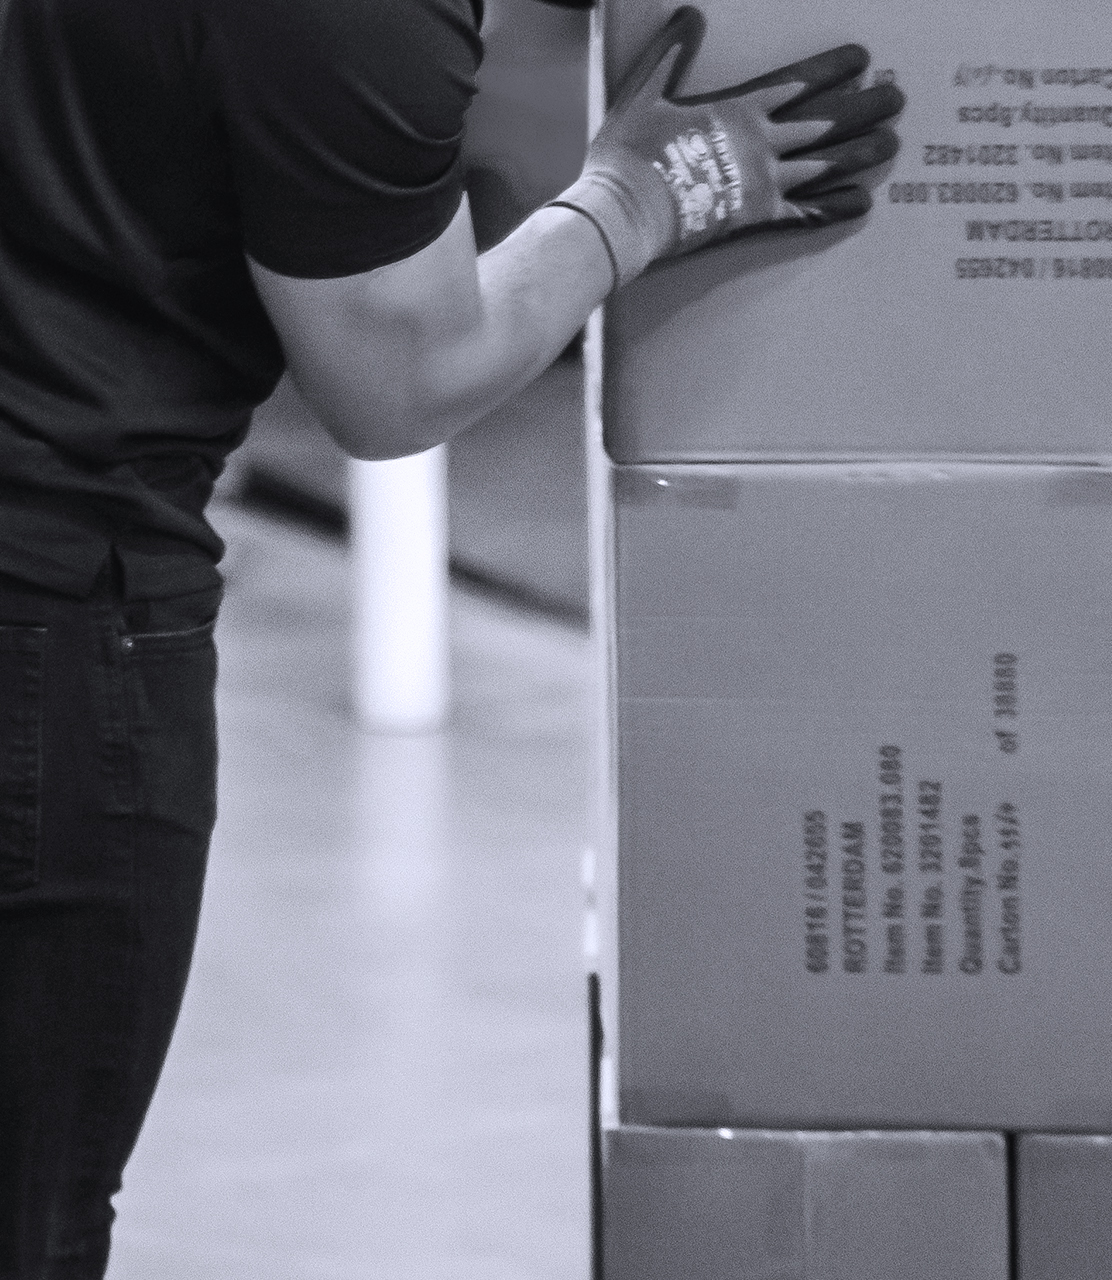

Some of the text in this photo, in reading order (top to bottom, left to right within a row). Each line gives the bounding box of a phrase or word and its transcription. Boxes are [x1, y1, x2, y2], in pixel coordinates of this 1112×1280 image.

[1070, 144, 1112, 163] tem
[1070, 182, 1112, 200] tem
[993, 730, 1019, 754] of
[841, 821, 867, 974] ROTTERDAM
[878, 745, 905, 974] Item No. 620083.080
[918, 780, 943, 974] Item No. 3201482
[996, 897, 1021, 975] Carton
